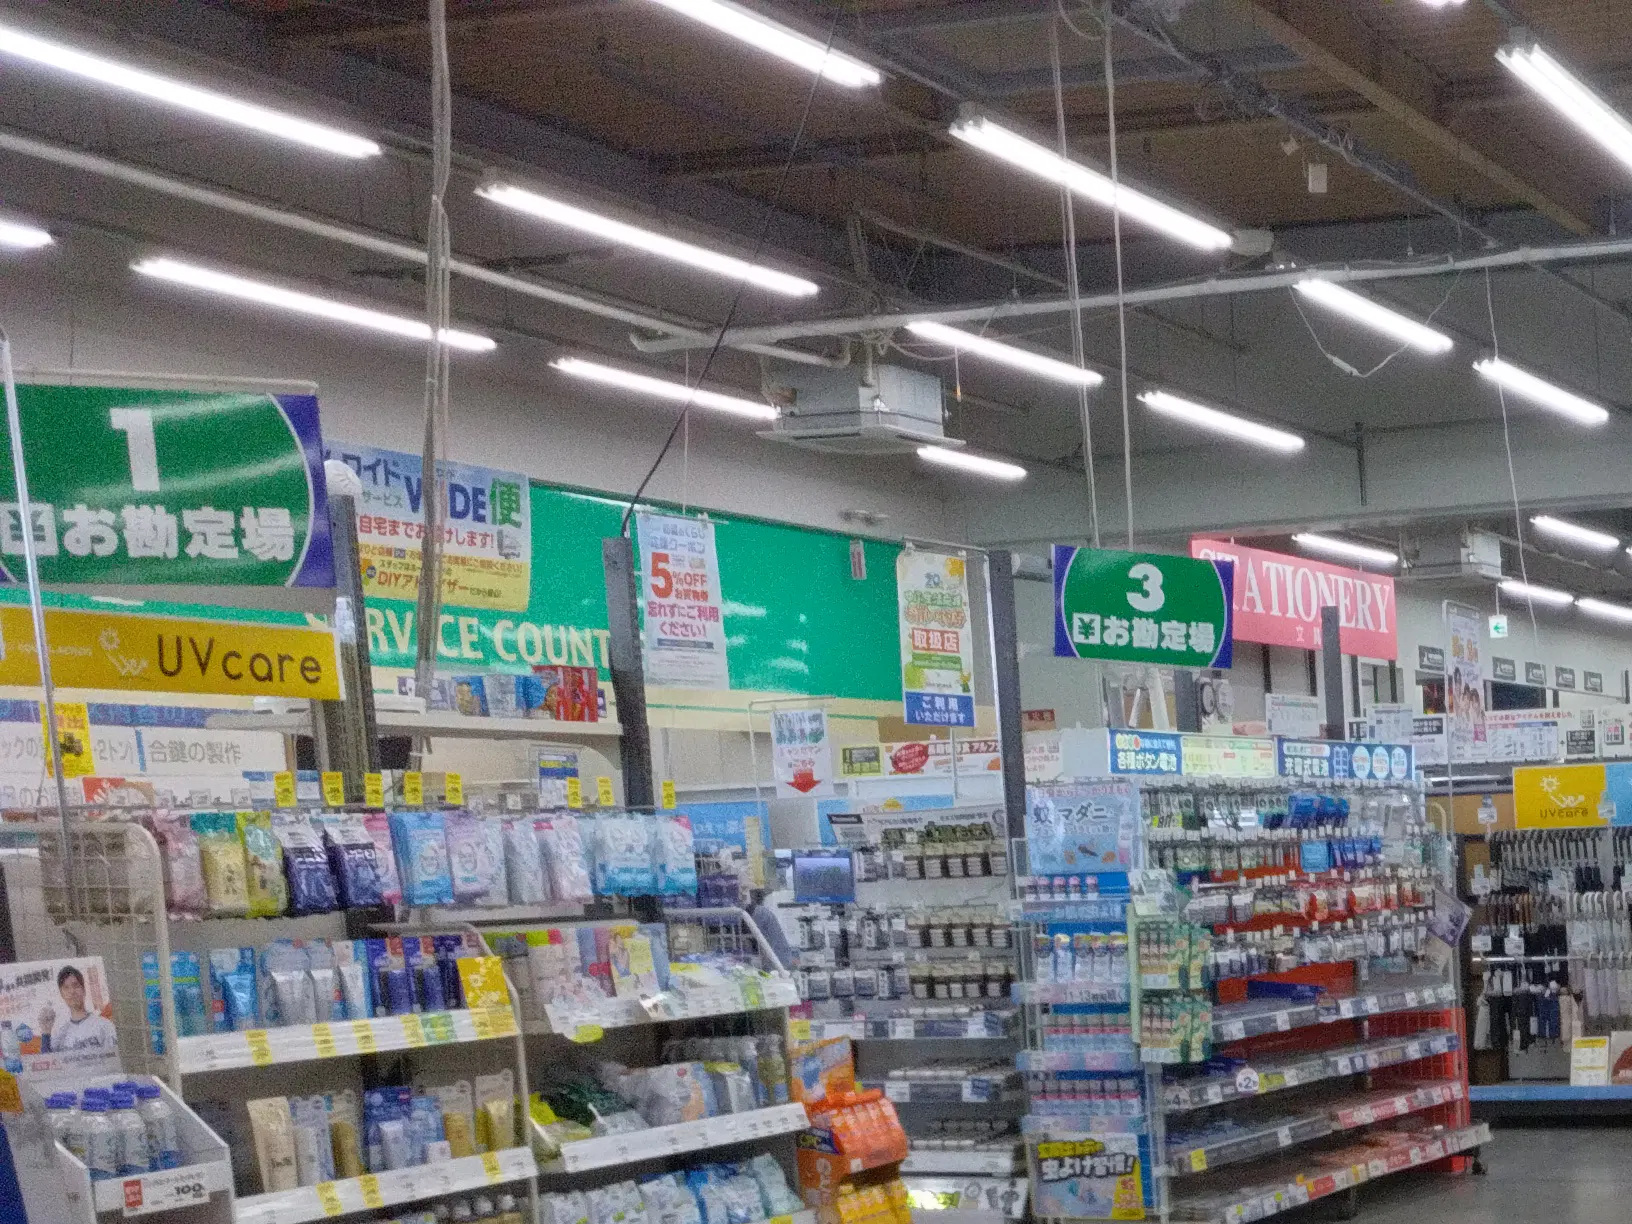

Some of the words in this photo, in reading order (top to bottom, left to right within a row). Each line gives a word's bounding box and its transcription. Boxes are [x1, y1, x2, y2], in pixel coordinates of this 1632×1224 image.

[111, 407, 160, 491] 1
[64, 507, 294, 561] お勘定場
[358, 514, 495, 549] 自宅までおけします!
[1126, 563, 1166, 613] 3
[1200, 548, 1391, 633] ATIONERY
[156, 633, 322, 685] UVcare
[913, 629, 959, 652] 取扱店
[1102, 616, 1215, 653] お勘定場
[921, 695, 959, 711] ご利用
